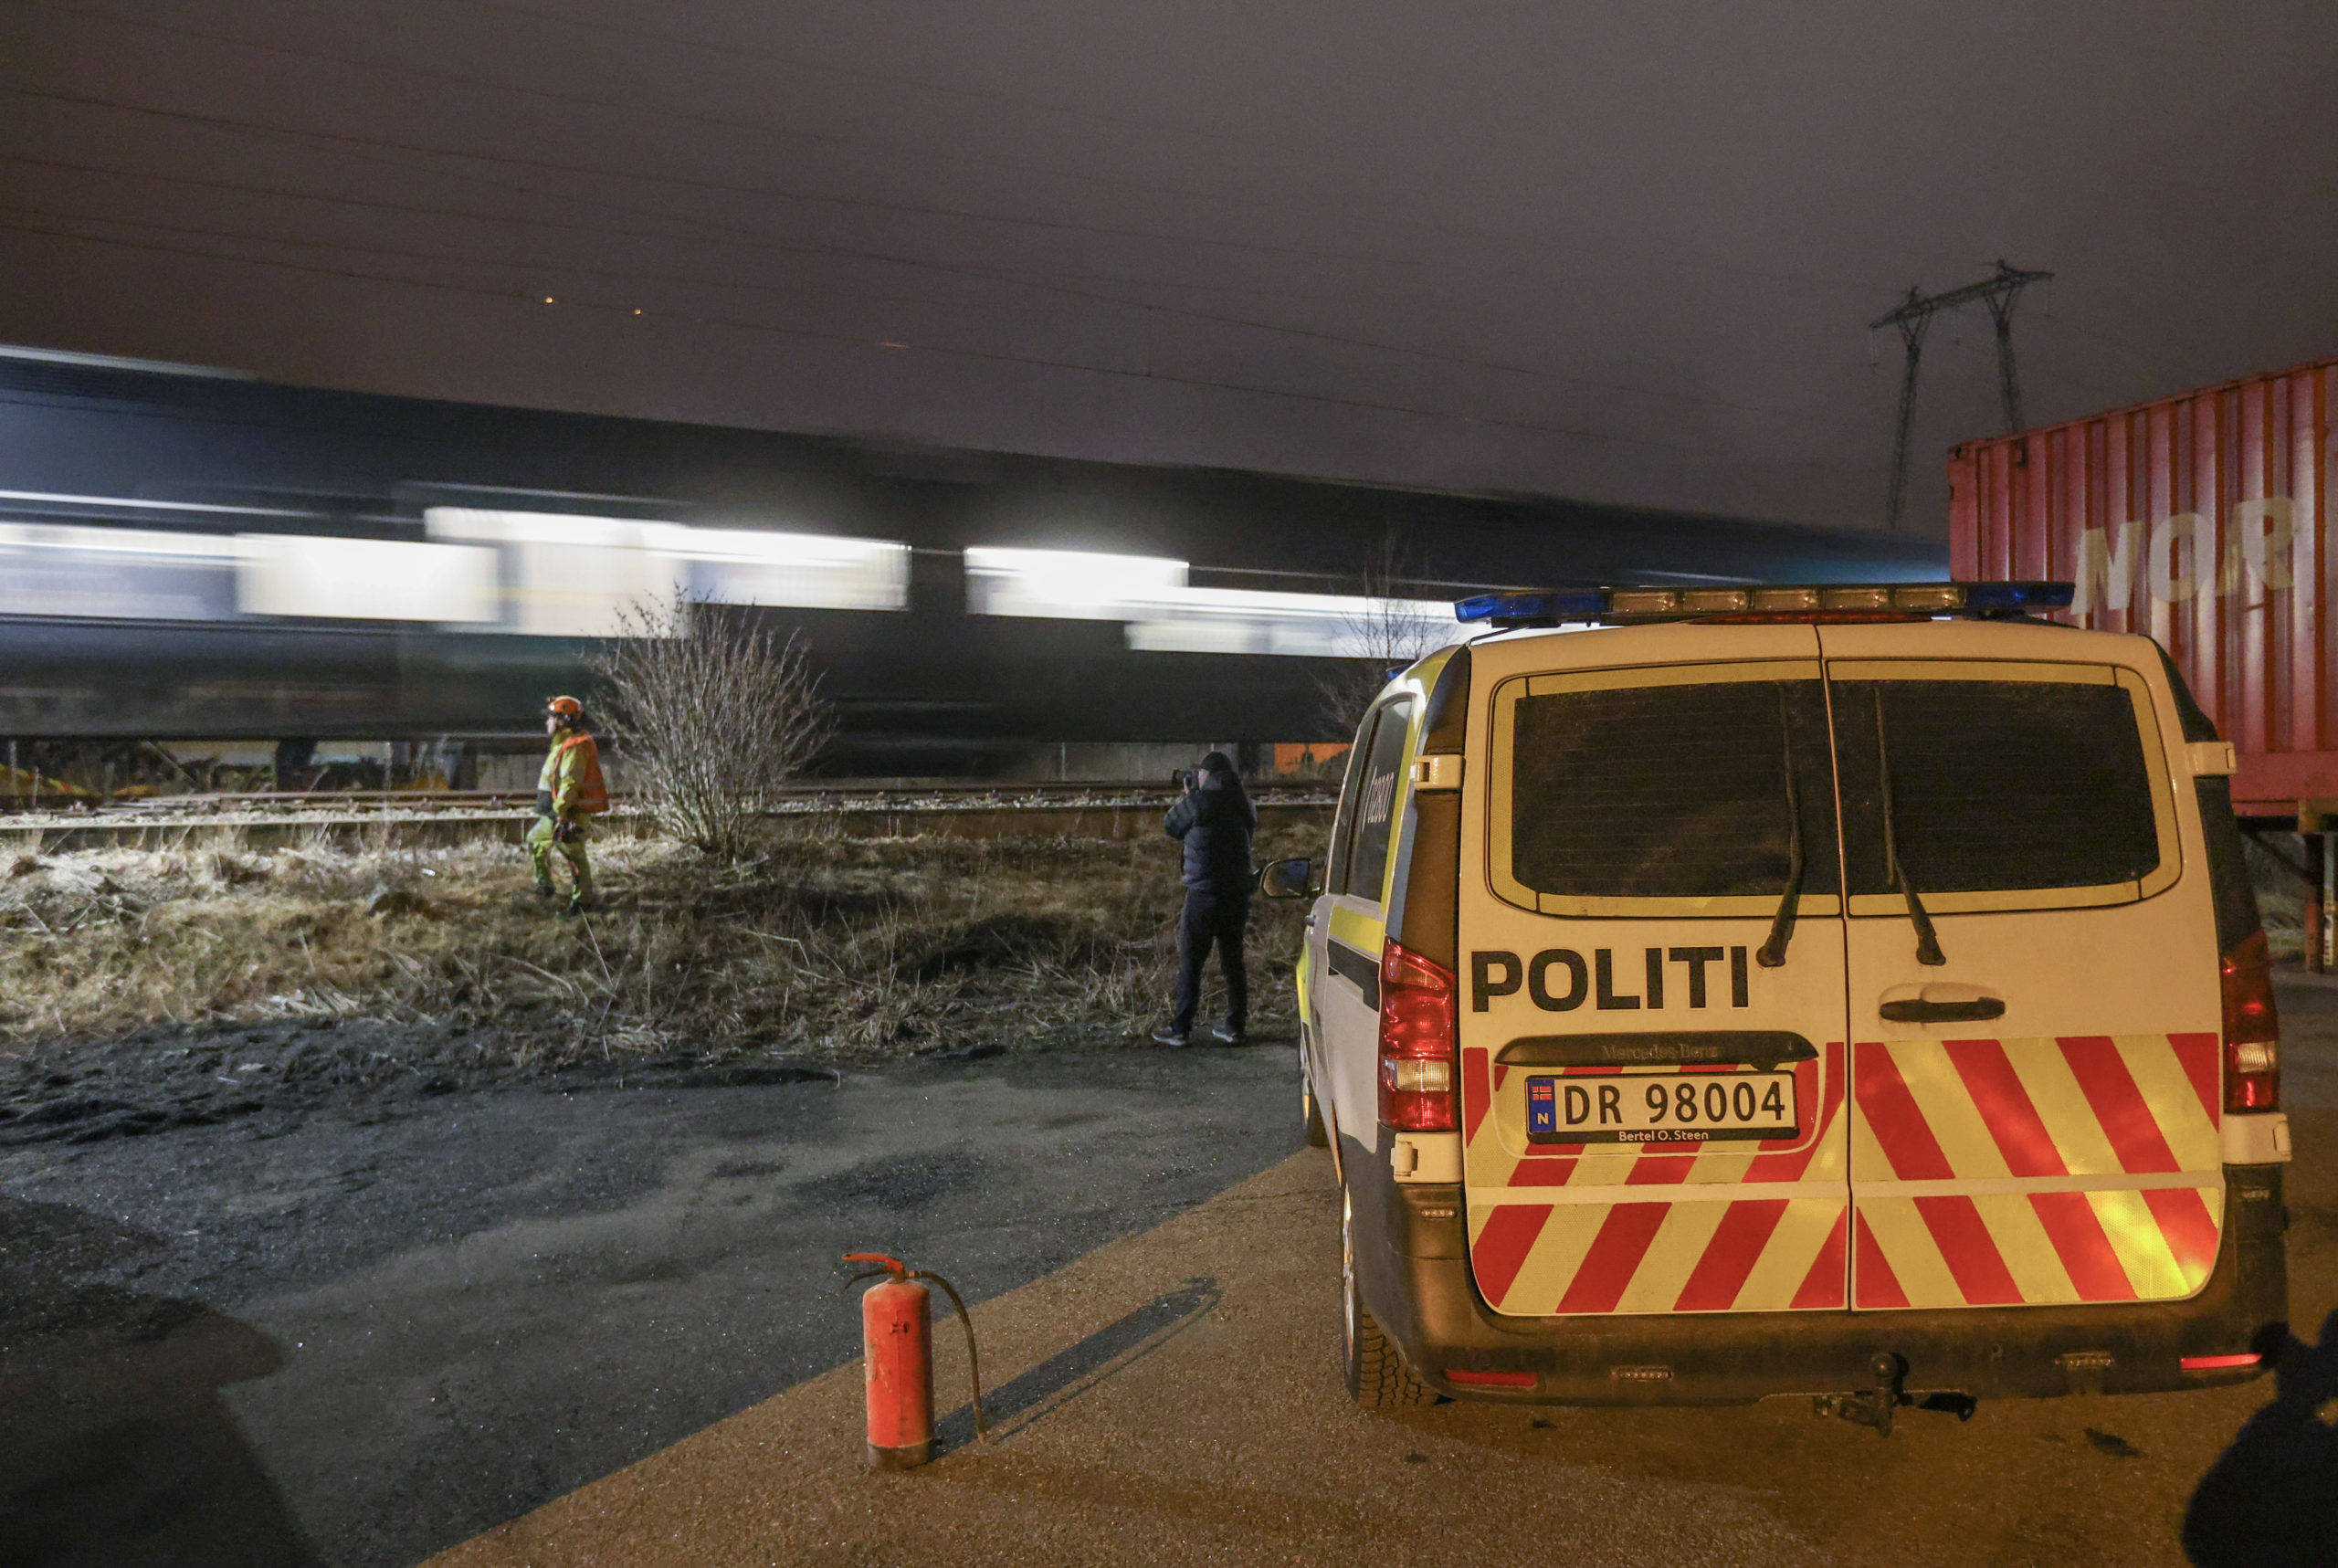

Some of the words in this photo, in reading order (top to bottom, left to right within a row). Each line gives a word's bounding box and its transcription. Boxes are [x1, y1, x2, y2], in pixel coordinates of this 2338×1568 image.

[2069, 496, 2295, 616] NOR
[1470, 946, 1749, 1013] POLITI
[1537, 1113, 1549, 1124] N
[1564, 1084, 1623, 1125] DR
[1646, 1081, 1785, 1124] 98004
[1618, 1131, 1655, 1142] Bertel
[1658, 1130, 1672, 1141] O.
[1674, 1130, 1709, 1141] Steen
